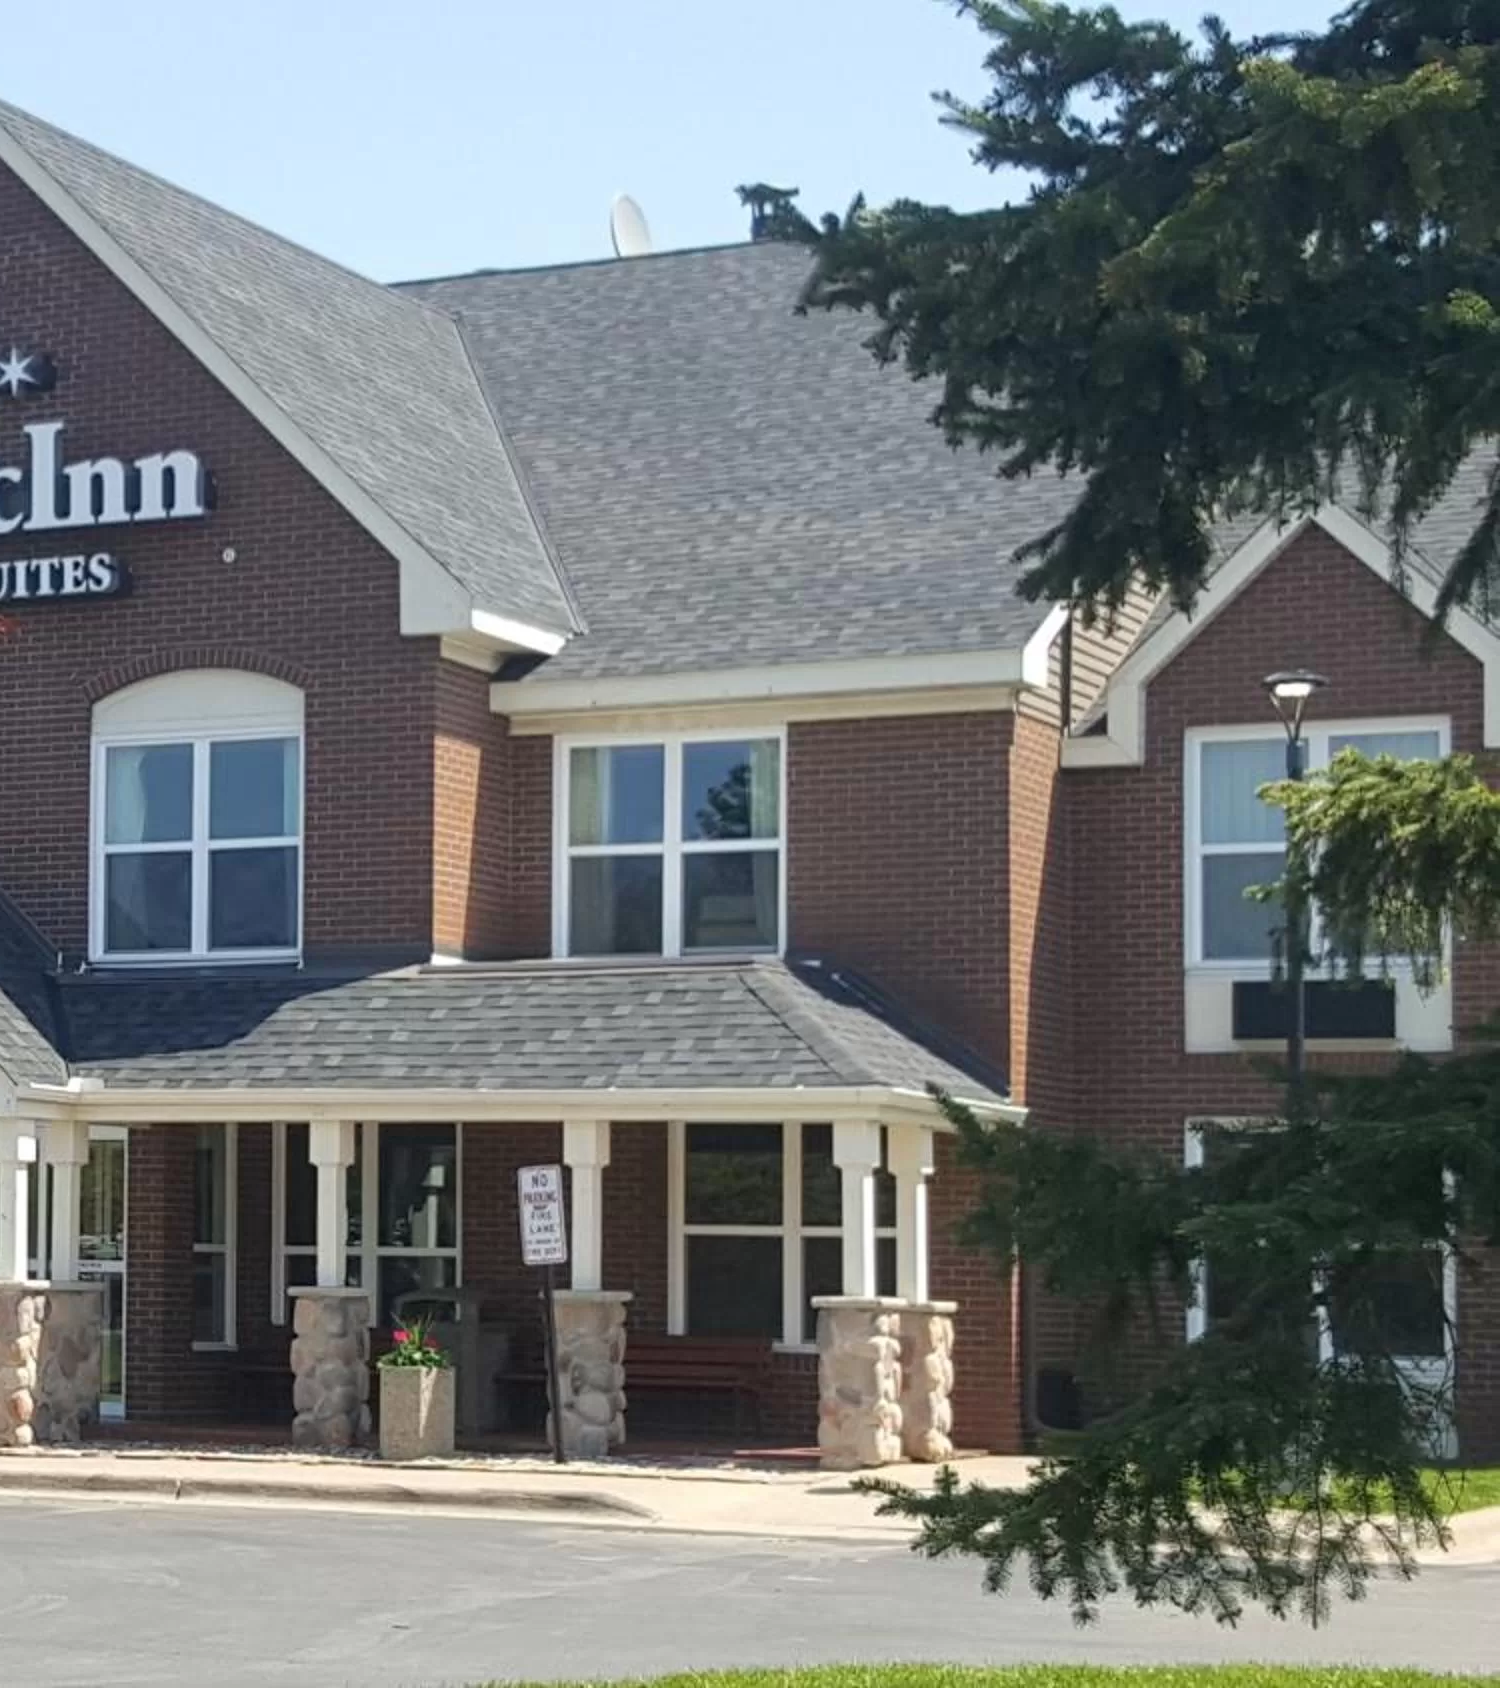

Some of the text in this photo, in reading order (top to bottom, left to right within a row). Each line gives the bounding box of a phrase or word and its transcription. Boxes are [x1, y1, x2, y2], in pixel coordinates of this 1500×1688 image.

[531, 1173, 549, 1189] NO
[523, 1190, 558, 1204] PARKING
[529, 1223, 556, 1234] LANE
